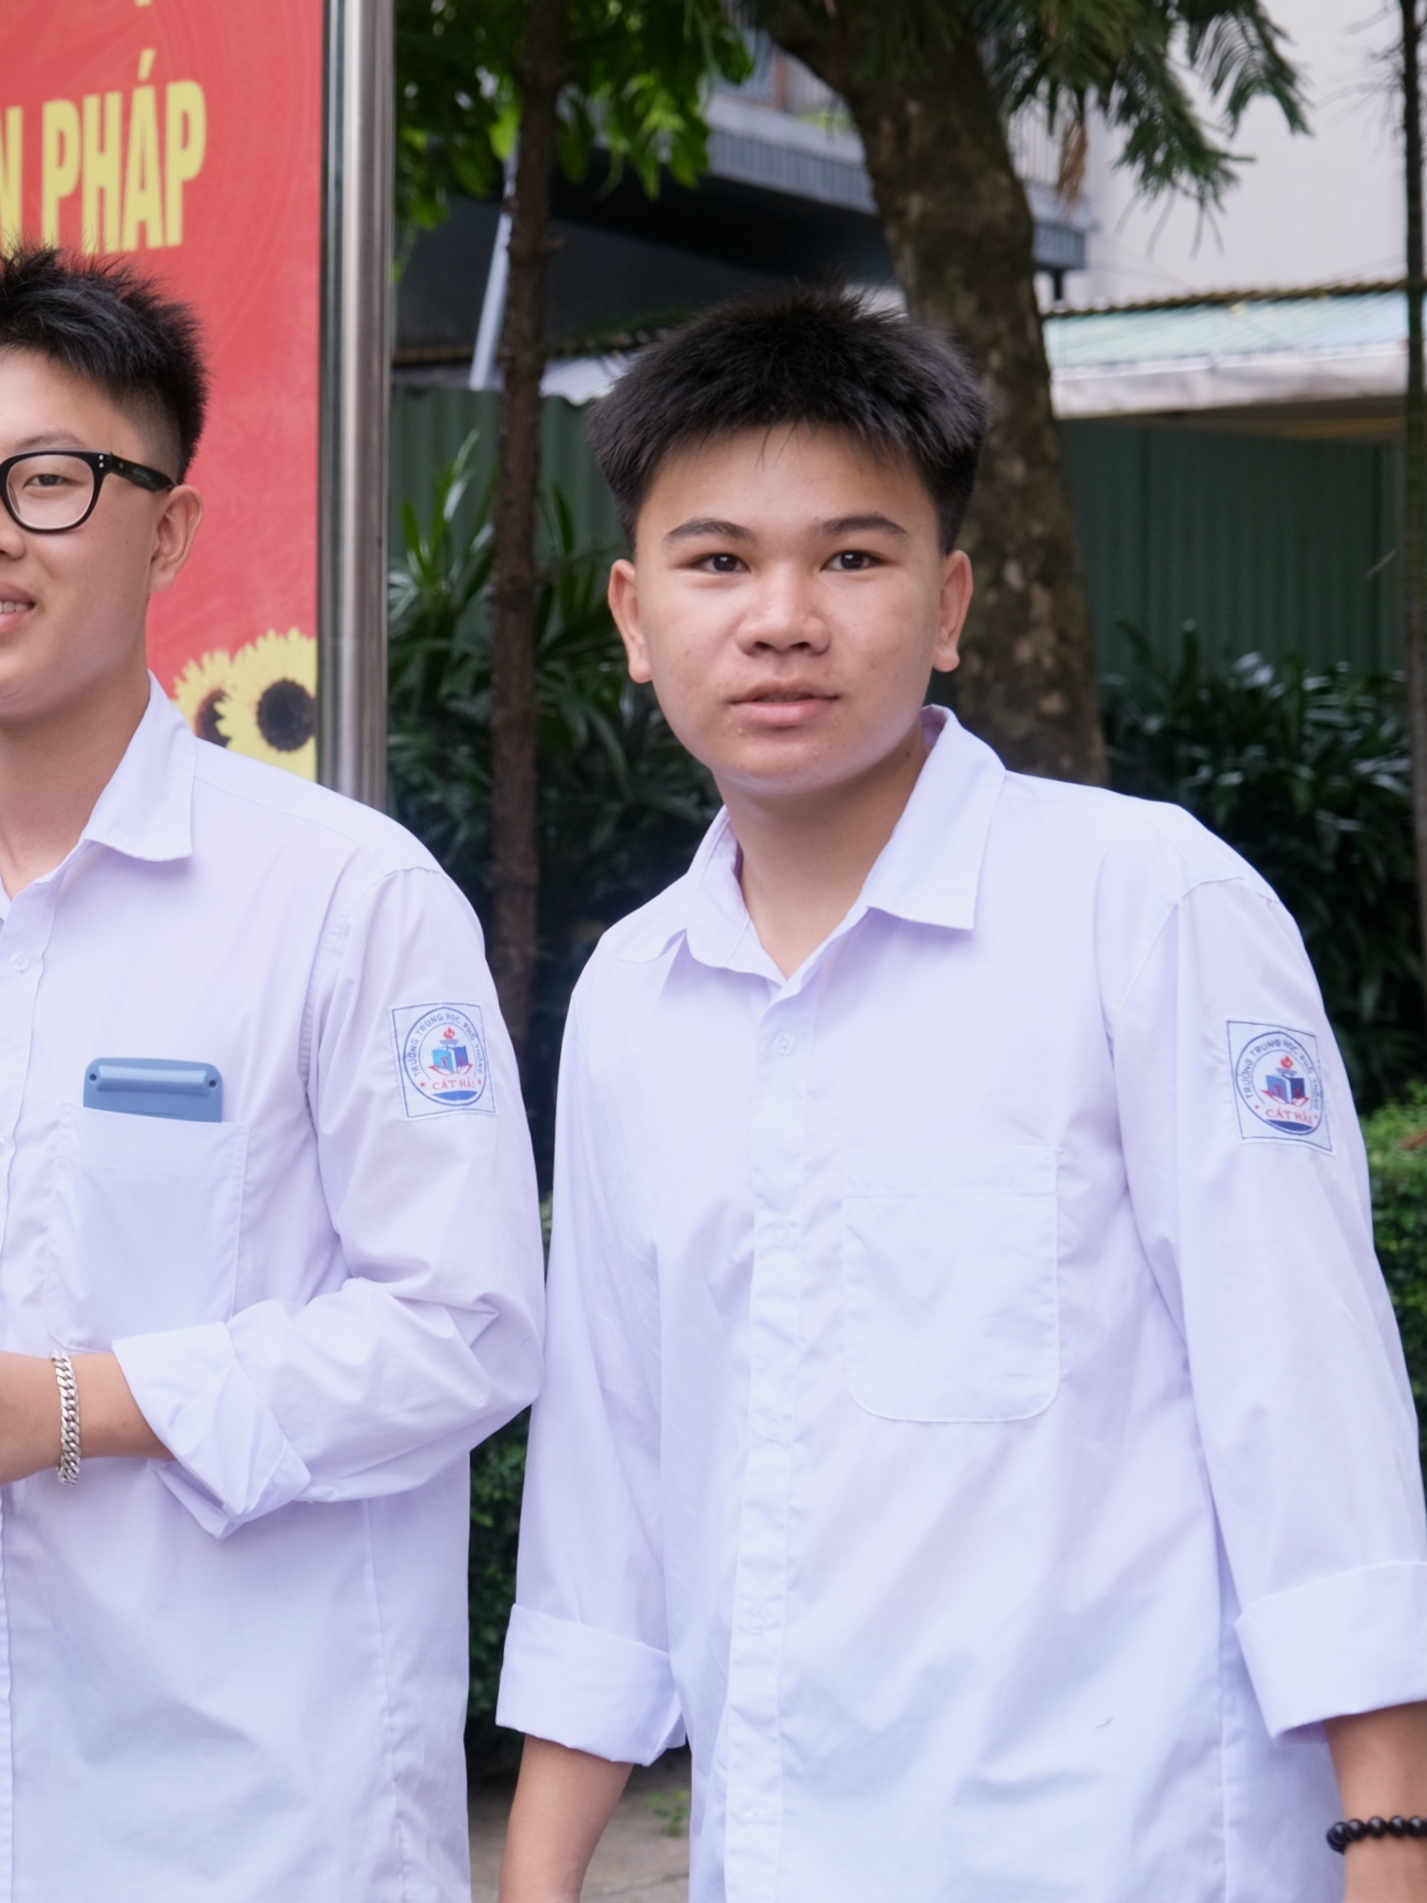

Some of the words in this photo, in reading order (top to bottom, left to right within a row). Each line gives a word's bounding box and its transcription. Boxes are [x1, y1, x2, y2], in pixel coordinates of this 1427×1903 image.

[41, 48, 206, 256] PHÁP
[416, 1013, 444, 1037] TRUNG
[1250, 1038, 1282, 1057] TRUNG
